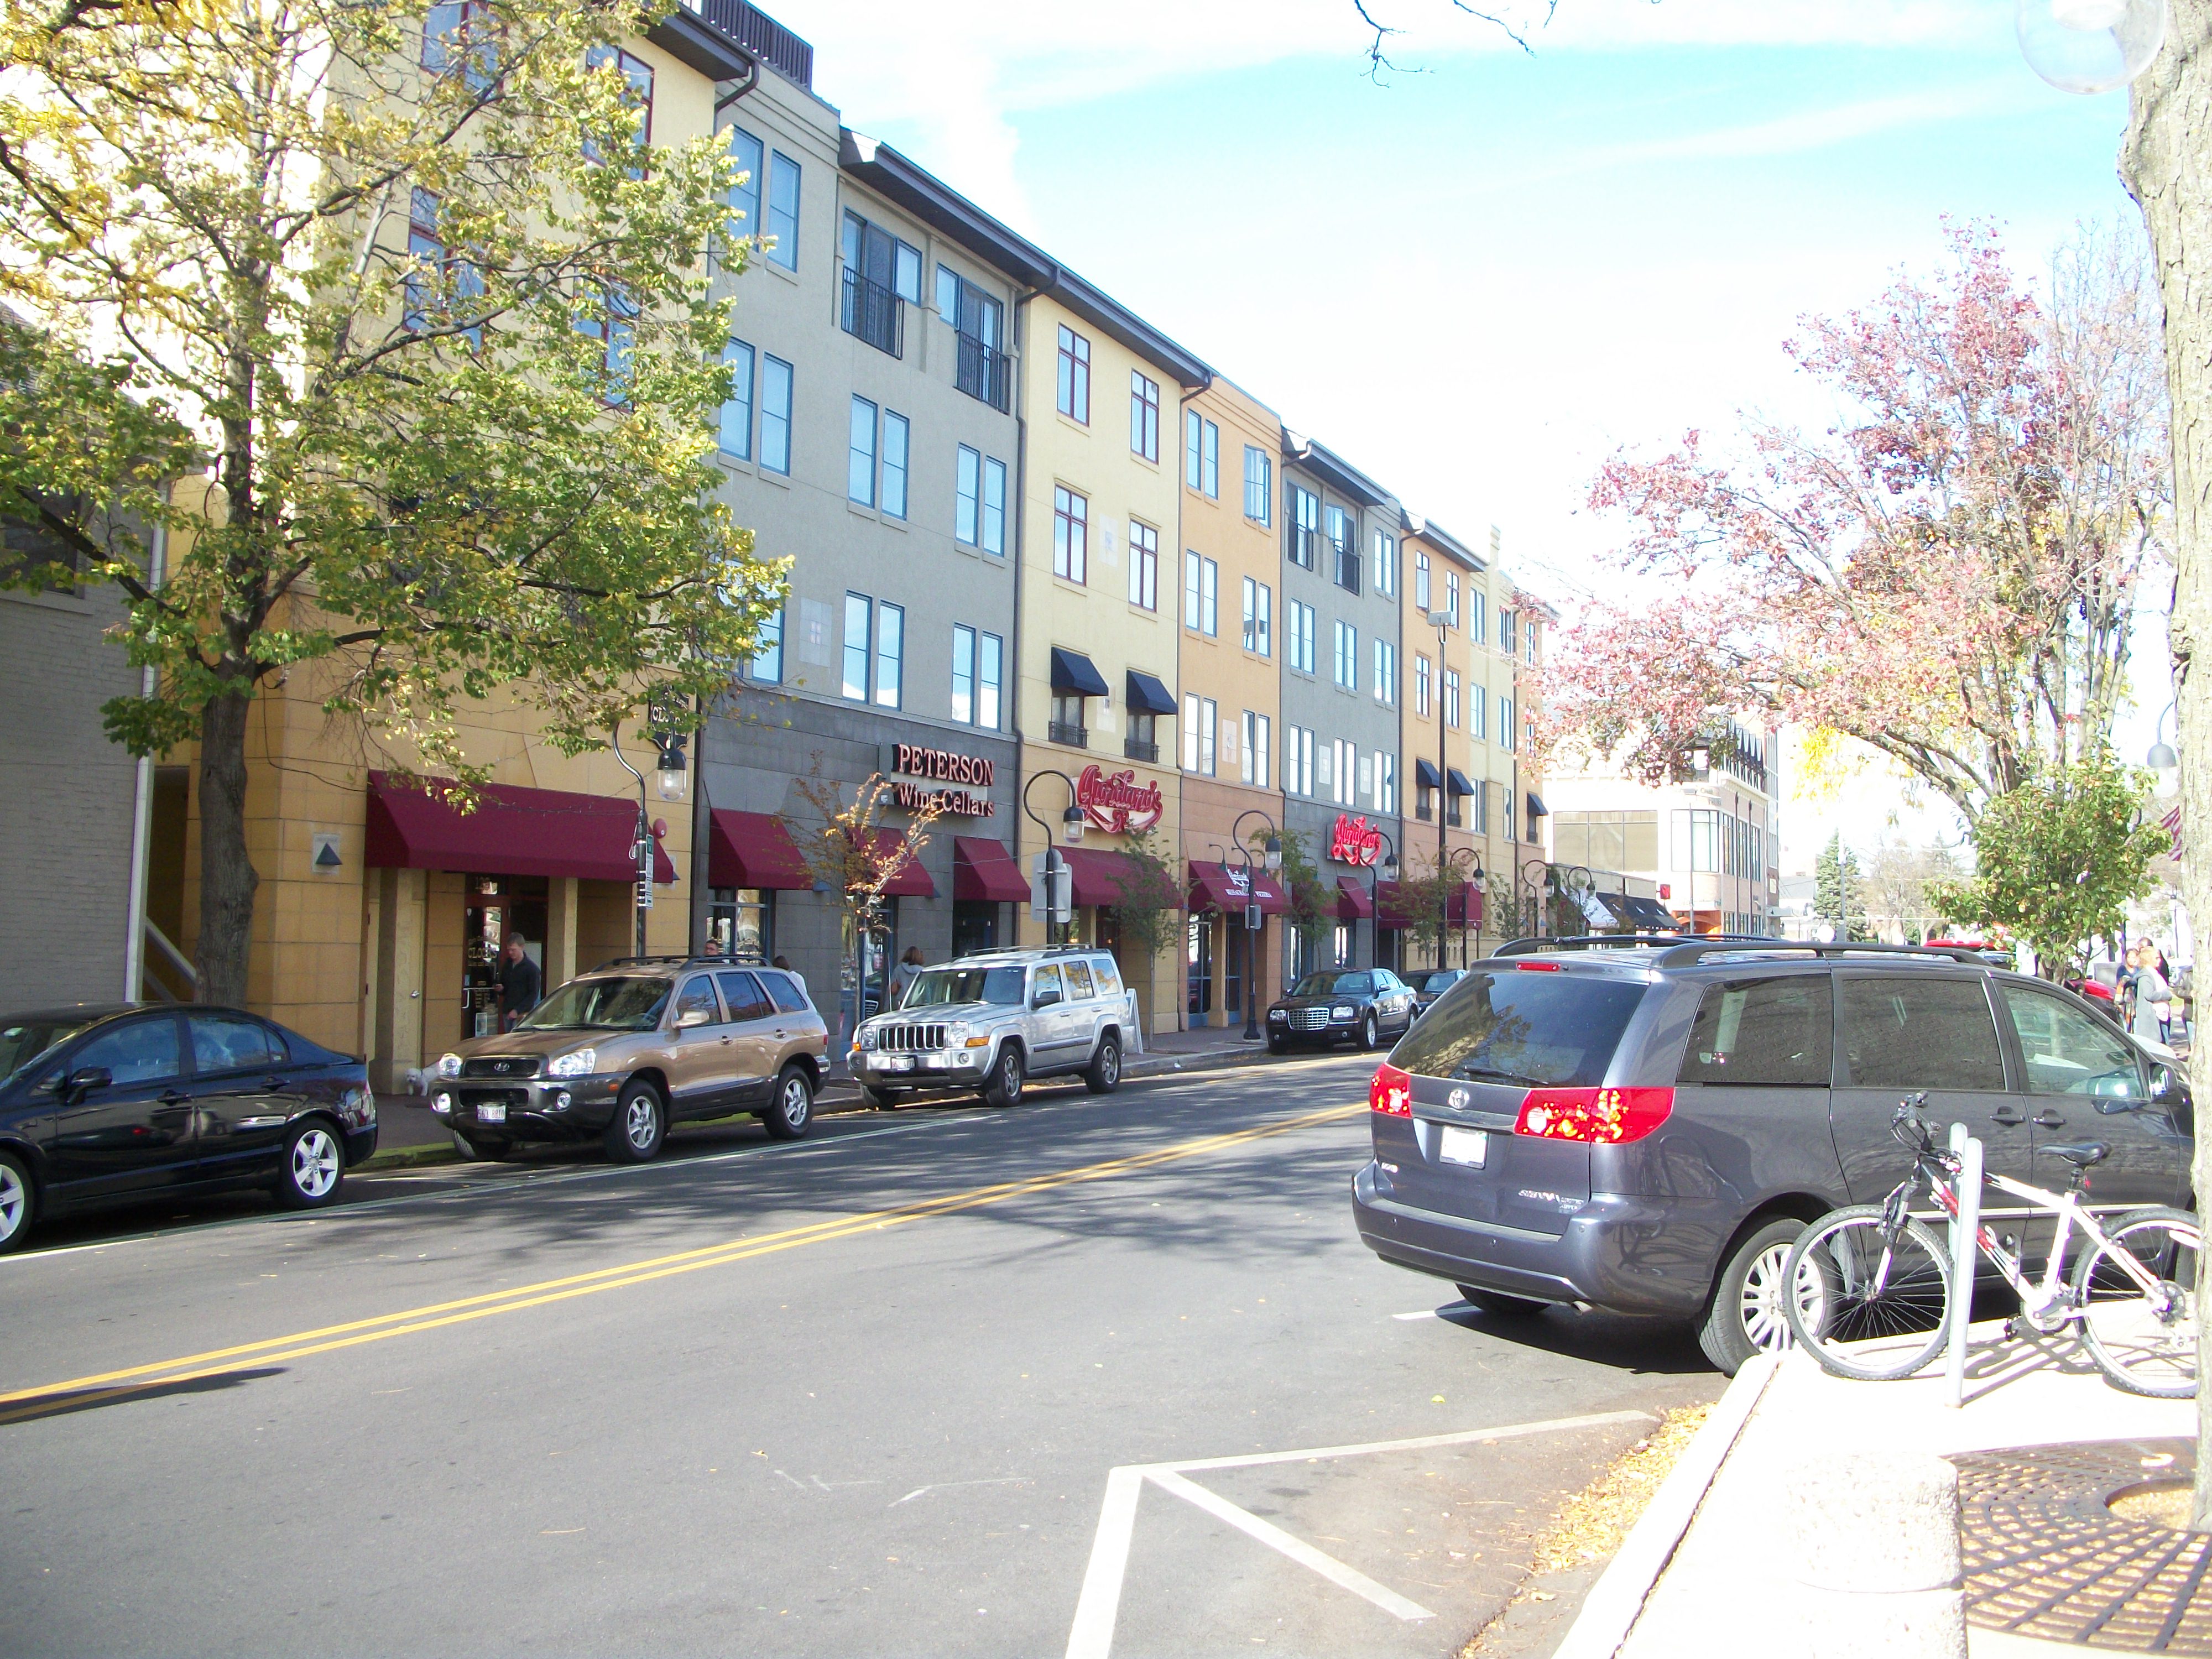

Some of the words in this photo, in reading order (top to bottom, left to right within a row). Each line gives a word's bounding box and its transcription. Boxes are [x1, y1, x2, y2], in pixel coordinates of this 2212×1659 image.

[899, 744, 995, 786] PETERSON
[899, 782, 937, 810] Wine
[942, 789, 995, 817] Cellars
